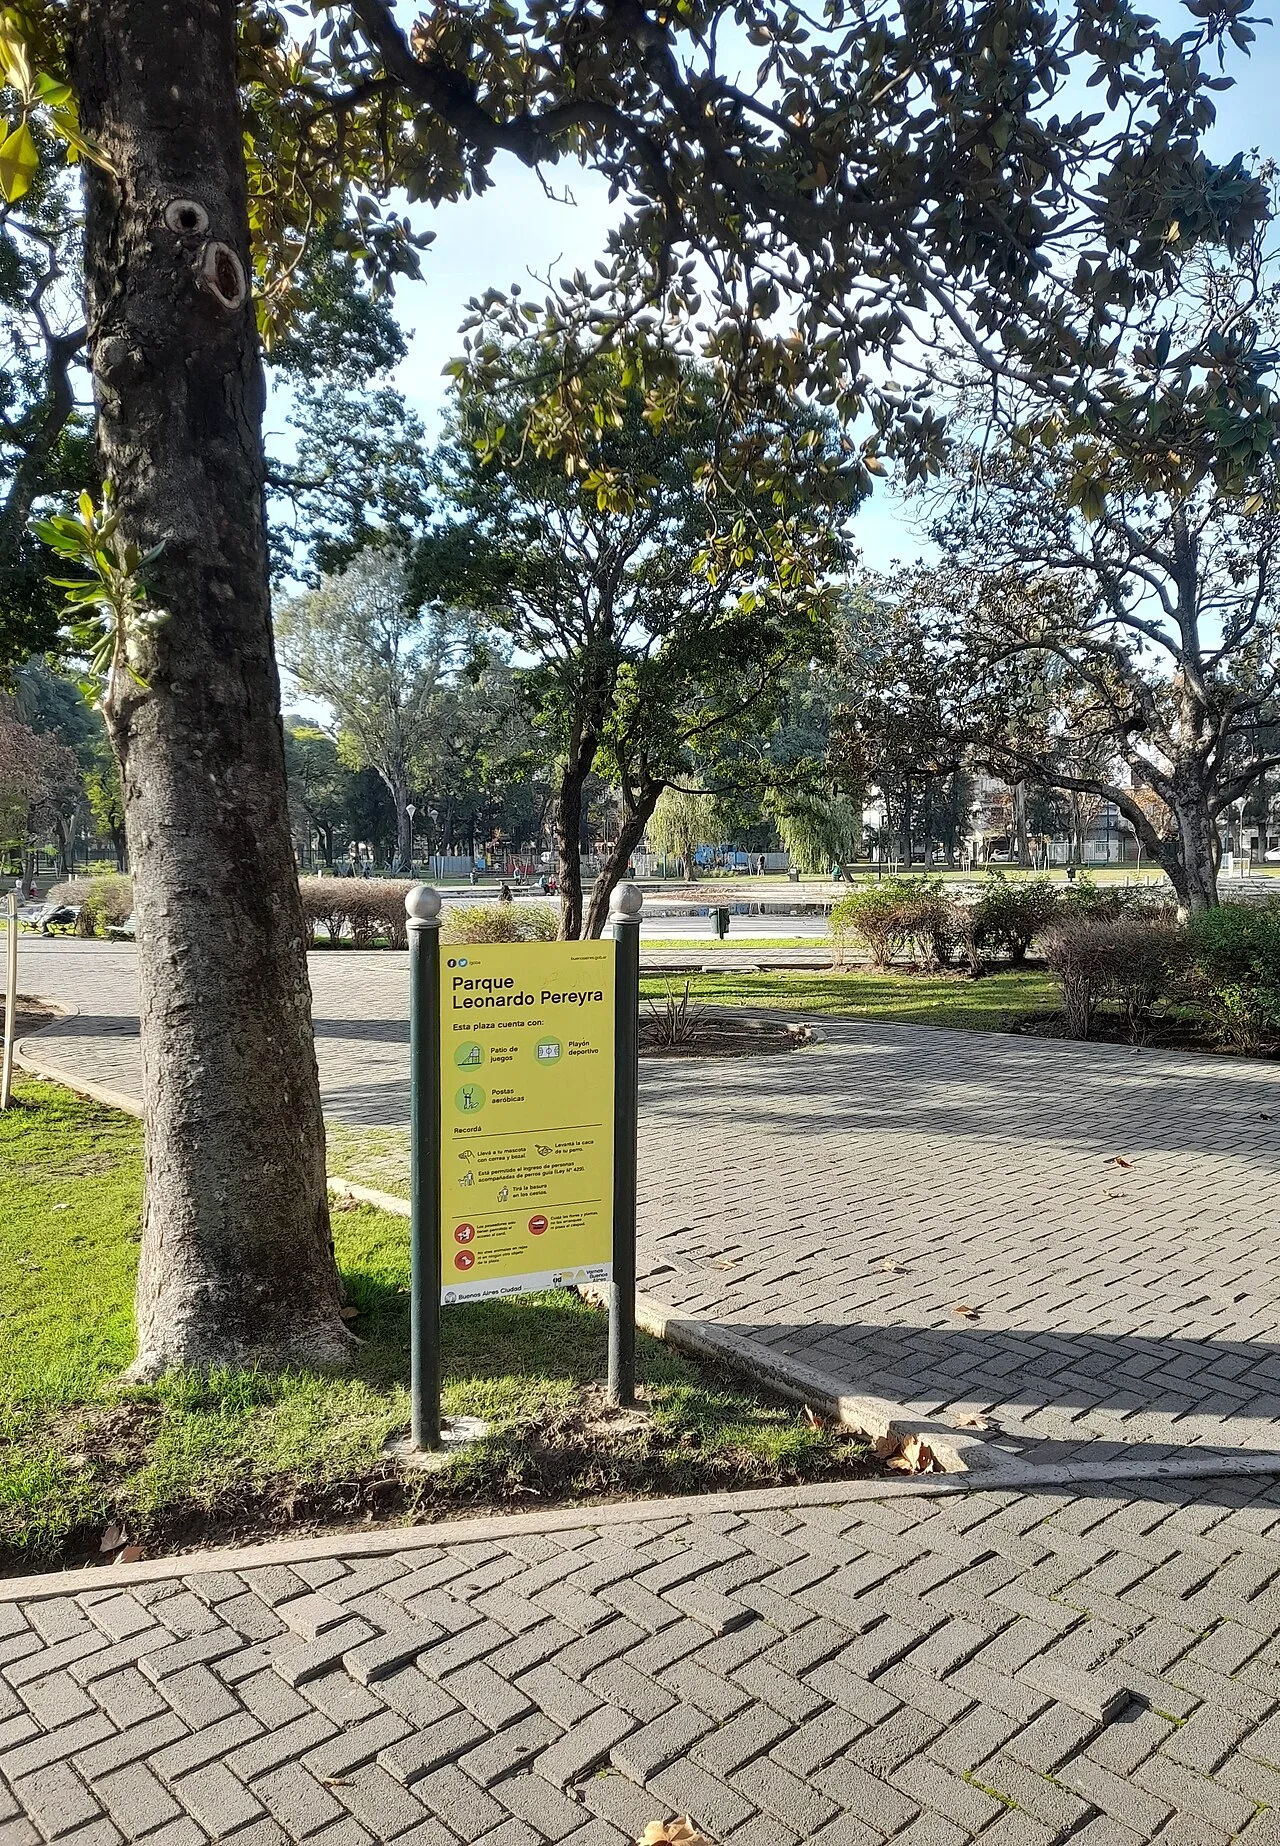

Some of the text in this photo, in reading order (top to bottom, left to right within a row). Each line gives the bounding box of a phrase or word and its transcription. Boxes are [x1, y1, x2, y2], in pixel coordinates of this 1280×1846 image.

[452, 976, 514, 994] Parque
[452, 990, 603, 1009] Leonardo Pereyra
[453, 1019, 544, 1031] Esta plaza cuenta con:
[569, 1040, 590, 1048] Playón
[490, 1046, 508, 1054] Patio
[569, 1048, 599, 1056] deportivo
[490, 1055, 513, 1063] juegos
[492, 1096, 525, 1104] aeróbicas
[454, 1126, 482, 1134] Recordá
[458, 1285, 522, 1300] Buenos Aires Ciudad
